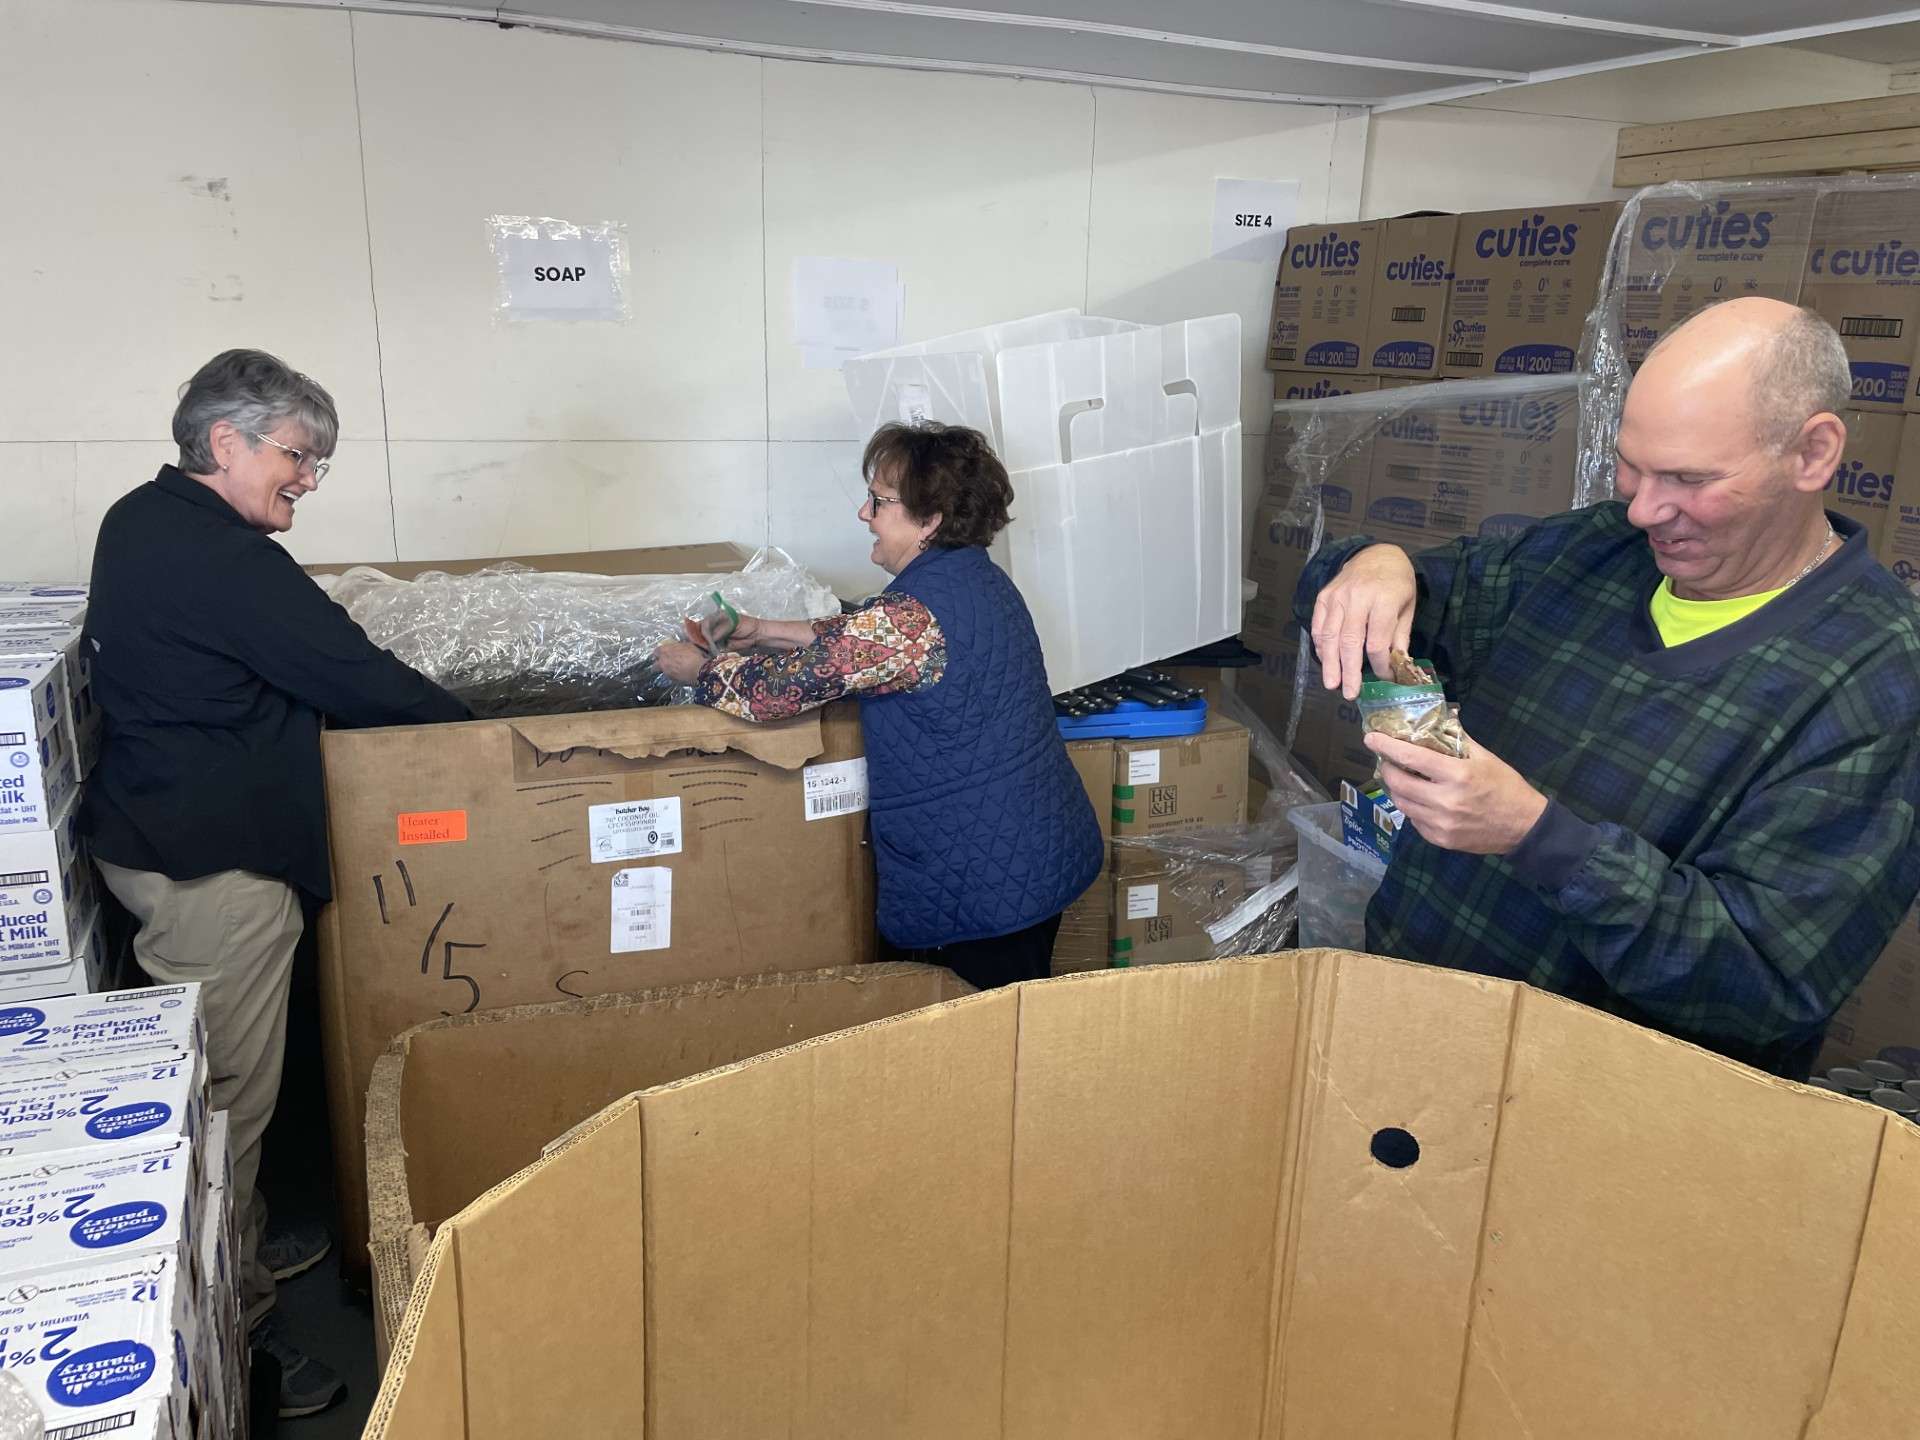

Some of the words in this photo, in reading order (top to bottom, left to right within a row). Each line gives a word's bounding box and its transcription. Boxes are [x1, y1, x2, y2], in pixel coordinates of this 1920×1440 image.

[1235, 214, 1262, 227] SIZE
[1264, 215, 1272, 228] 4
[1641, 201, 1774, 250] cuties
[1476, 214, 1579, 259] cuties
[1291, 232, 1361, 270] cuties
[1697, 253, 1739, 263] complete
[1741, 252, 1763, 262] care
[1829, 240, 1920, 276] cutie
[1387, 254, 1445, 281] cuties
[1520, 258, 1549, 269] complete
[1551, 257, 1571, 267] care
[534, 266, 586, 281] SOAP
[1328, 352, 1344, 364] 200
[1399, 353, 1416, 366] 200
[1516, 355, 1525, 371] 4
[1529, 356, 1551, 372] 200
[1853, 378, 1886, 397] 200
[1823, 461, 1894, 500] ties
[1152, 788, 1175, 803] H&
[1152, 801, 1175, 815] &H
[402, 829, 449, 841] Installed
[10, 926, 48, 941] Milk
[72, 1013, 162, 1032] Reduced
[72, 1029, 107, 1041] Fat
[112, 1022, 158, 1037] Milk
[152, 1066, 178, 1080] 12
[79, 1086, 118, 1096] Vitamin
[17, 1101, 55, 1113] Fat
[94, 1107, 156, 1124] pantry
[96, 1113, 166, 1130] modern
[142, 1158, 173, 1174] 12
[62, 1183, 106, 1194] Vitamin
[79, 1208, 150, 1229] pantry
[82, 1215, 160, 1234] modern
[132, 1284, 159, 1302] 12
[27, 1322, 37, 1330] A
[40, 1312, 90, 1327] Vitamin
[9, 1326, 78, 1368] 2%
[58, 1352, 137, 1378] pantry
[62, 1361, 148, 1387] modern
